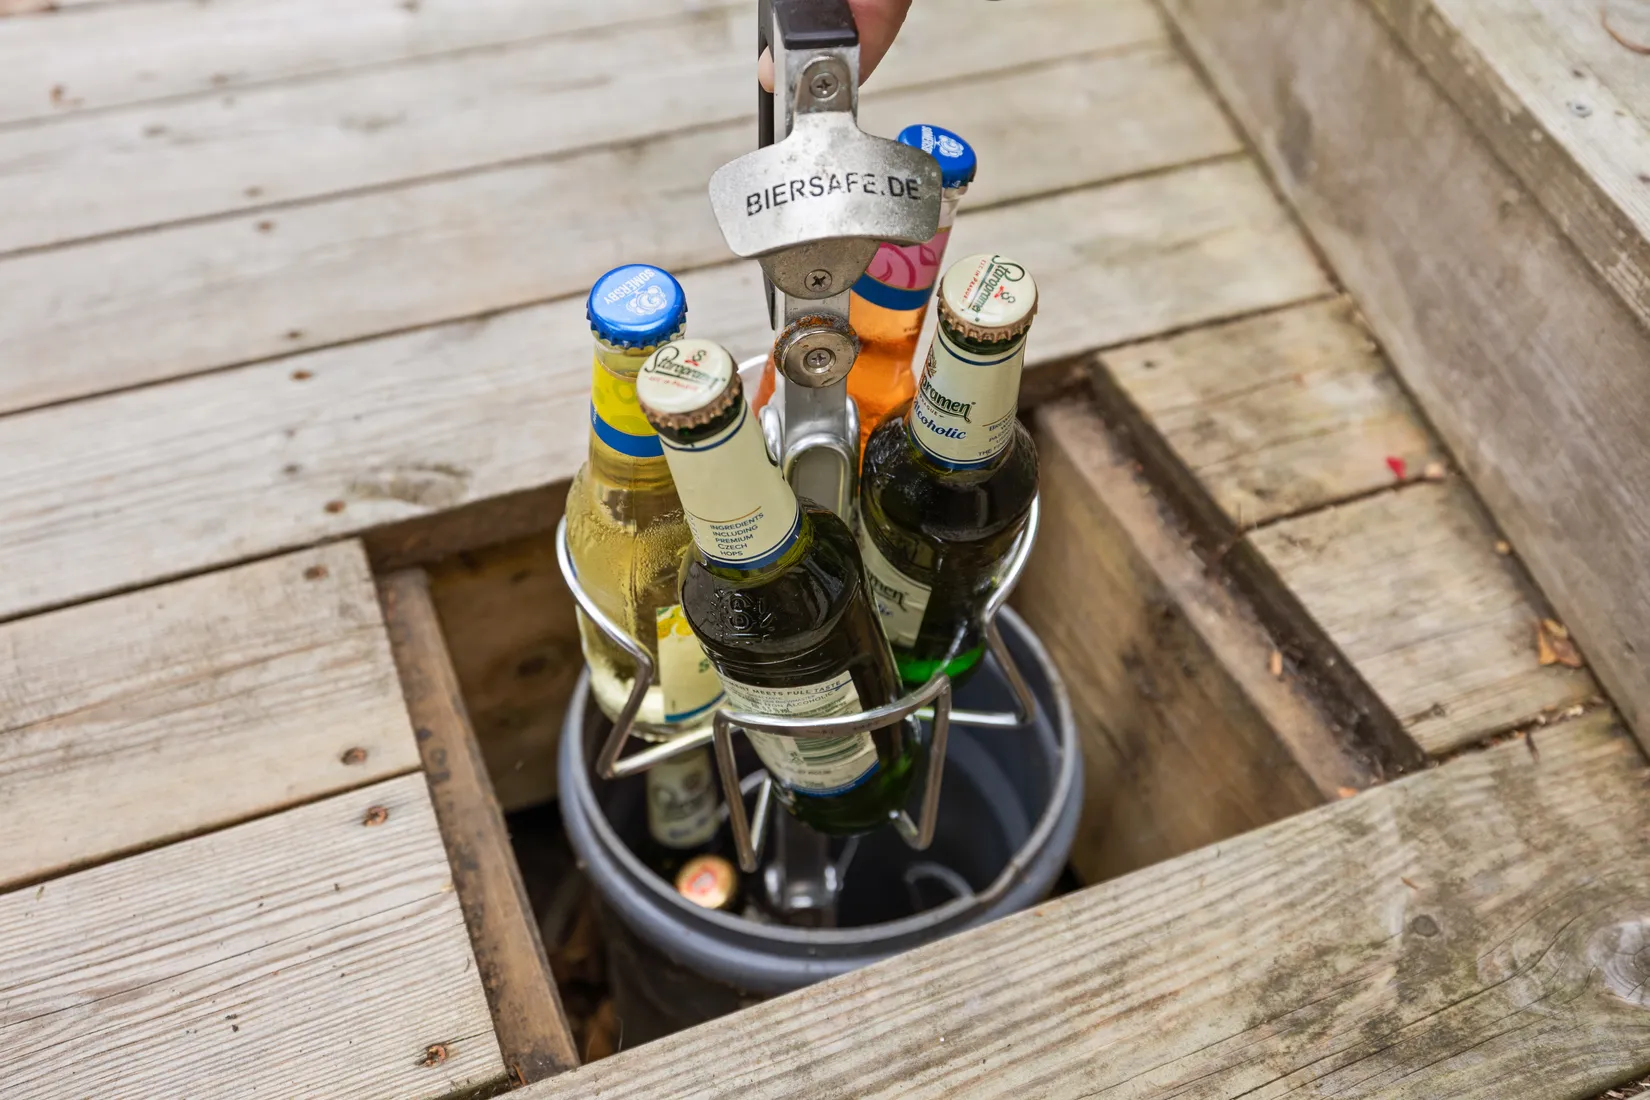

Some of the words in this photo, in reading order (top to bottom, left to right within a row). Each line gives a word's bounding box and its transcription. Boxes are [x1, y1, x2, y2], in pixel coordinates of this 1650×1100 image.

[746, 173, 921, 217] BIERSAFE.DE
[603, 268, 656, 305] SOMERSBY
[709, 512, 764, 531] INGREDIENTS
[712, 524, 758, 538] INCLUDING
[715, 534, 754, 543] PREMIUM
[814, 680, 841, 693] TASTE
[787, 692, 834, 708] ALCOHOLIC
